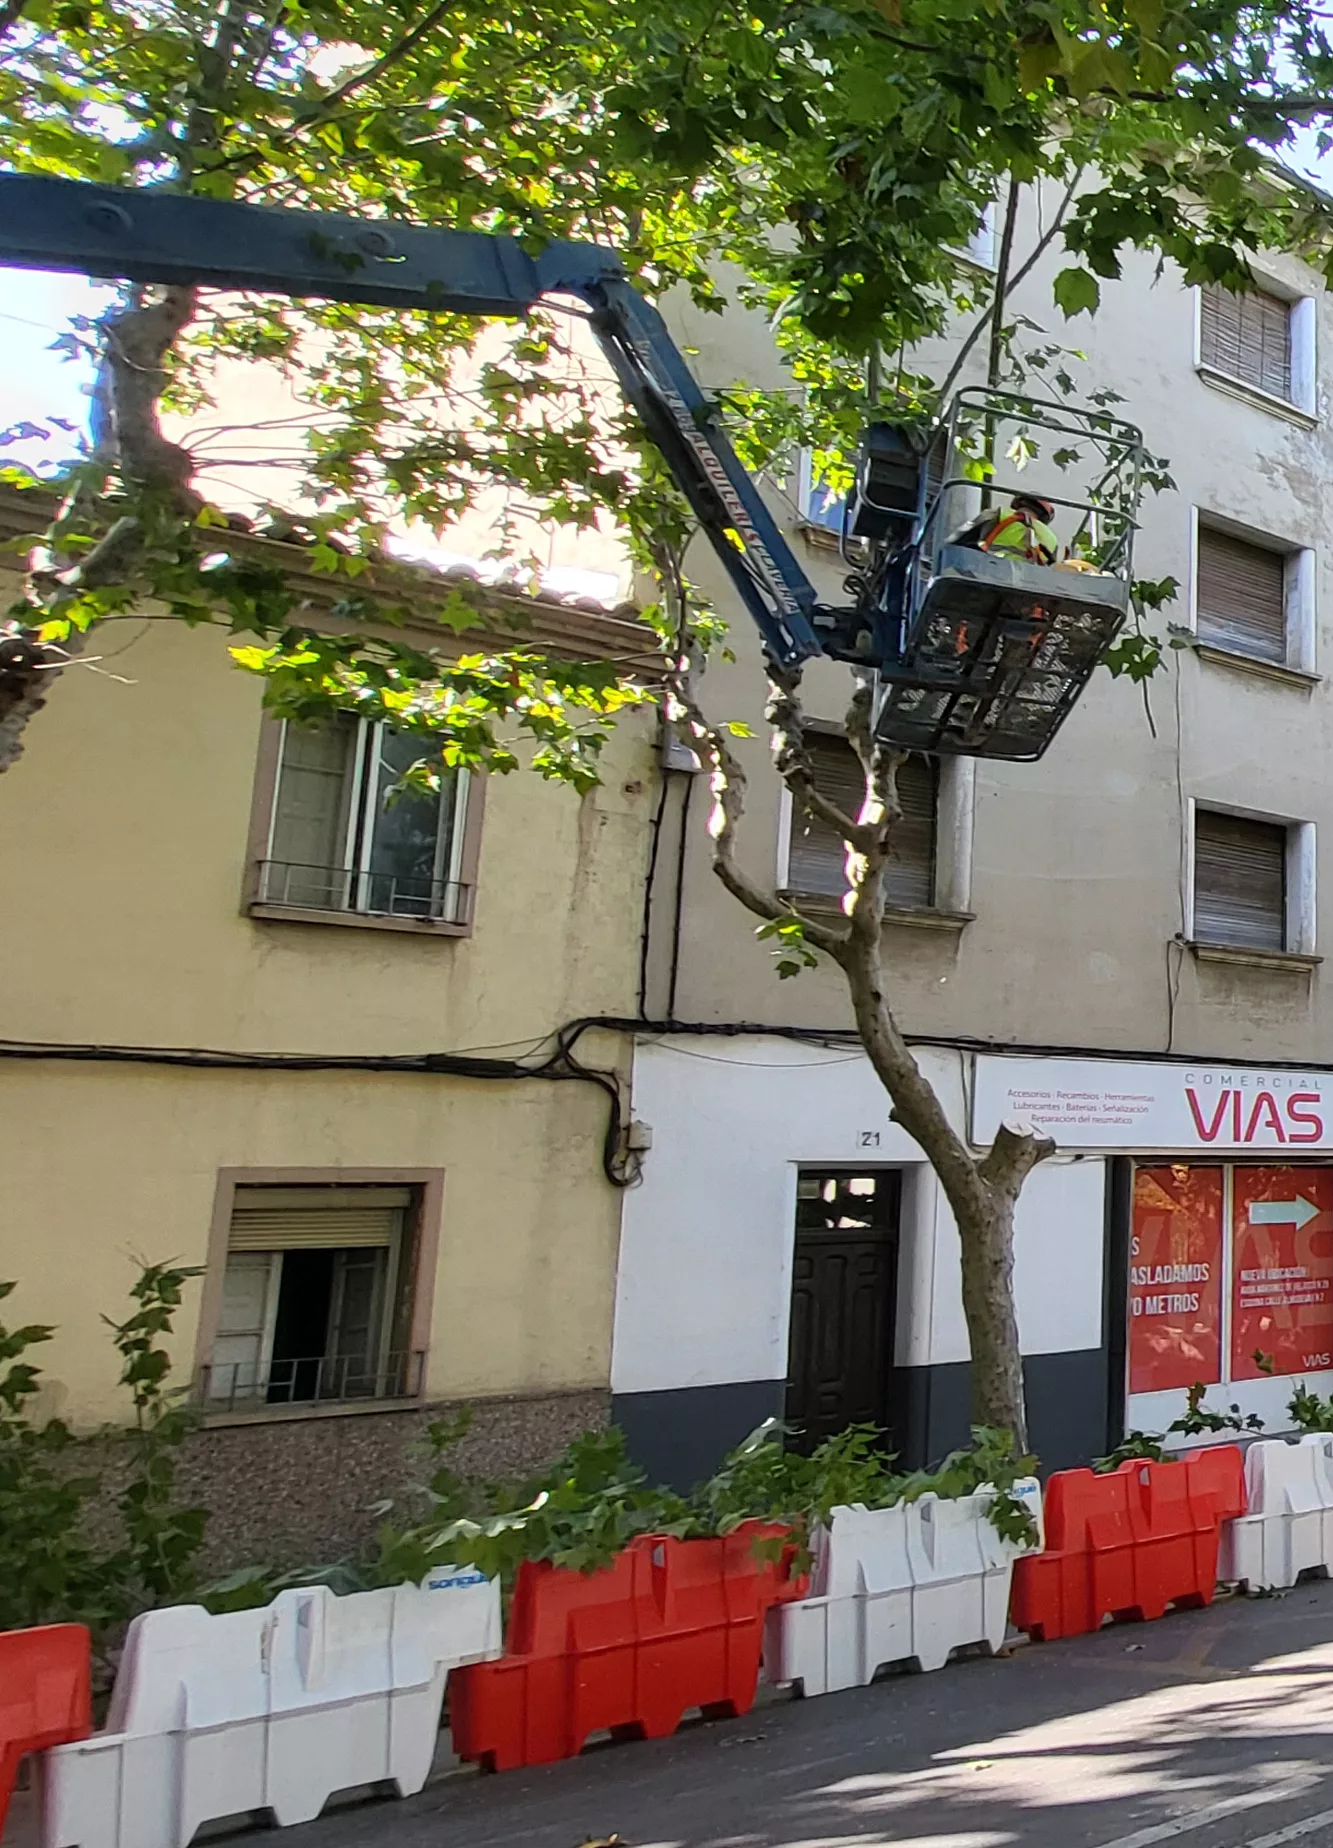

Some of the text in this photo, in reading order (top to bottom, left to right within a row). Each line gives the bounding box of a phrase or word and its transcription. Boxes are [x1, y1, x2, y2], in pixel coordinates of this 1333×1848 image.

[1185, 1073, 1322, 1090] COMERCIAL
[1008, 1089, 1155, 1102] Accesorios Recambios Herramientas
[1013, 1102, 1060, 1111] Lubricantes
[1079, 1114, 1090, 1123] del
[1185, 1088, 1324, 1143] VIAS
[861, 1131, 880, 1146] 21
[1146, 1293, 1200, 1316] METROS
[1302, 1353, 1331, 1367] VIAS
